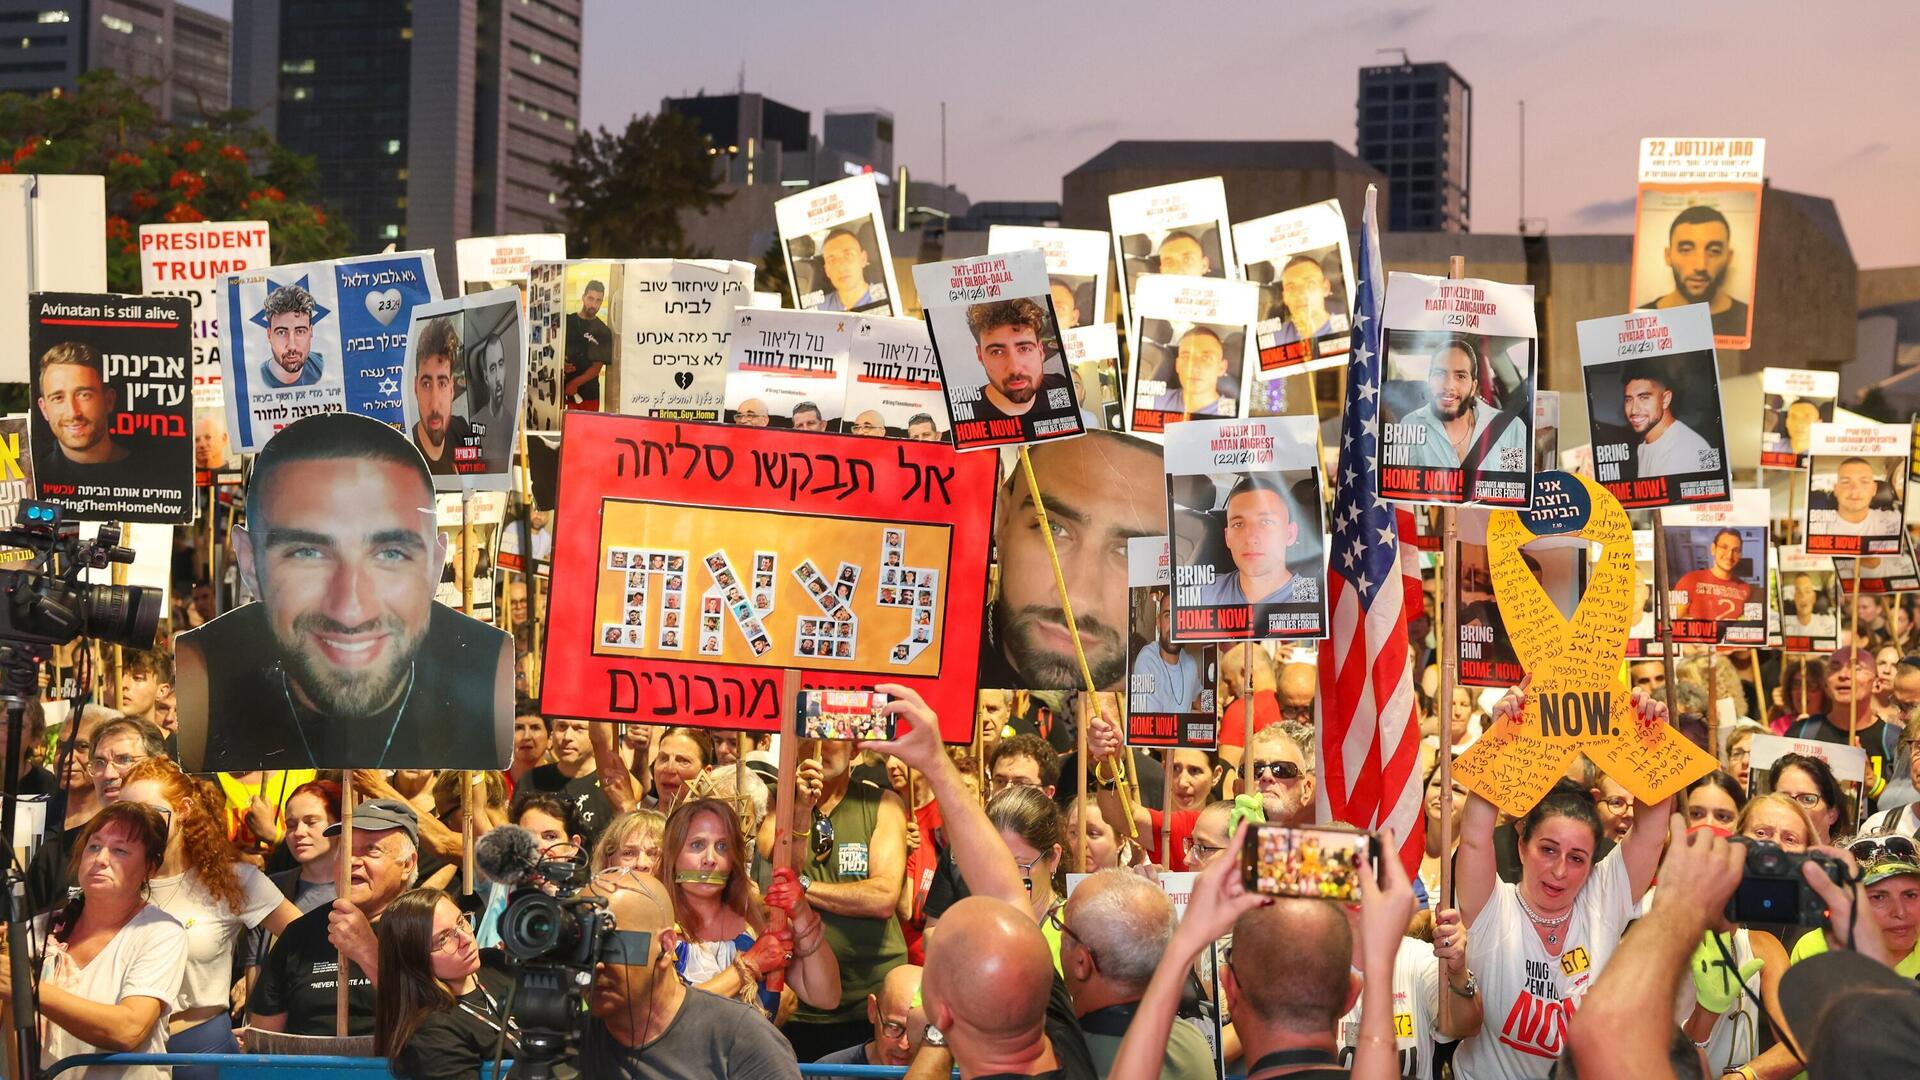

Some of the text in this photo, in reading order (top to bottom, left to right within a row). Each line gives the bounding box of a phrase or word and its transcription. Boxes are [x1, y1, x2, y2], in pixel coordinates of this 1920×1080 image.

[1650, 141, 1666, 157] 22
[141, 230, 266, 251] PRESIDENT
[152, 260, 248, 282] TRUMP
[341, 269, 418, 288] גיא גלבוע דלאל
[950, 271, 1014, 289] GUY GILBOA-DALAL
[640, 281, 719, 292] שיחזור שוב
[40, 303, 180, 320] Avinatan is still alive.
[665, 298, 711, 314] לביתו
[1425, 299, 1497, 316] MATAN ZANGAUKER
[1443, 313, 1465, 327] (25)
[346, 336, 375, 352] בבית
[637, 332, 708, 345] מזה אנחנו
[759, 330, 826, 352] טל וליאור
[1618, 326, 1669, 343] EVYATAR DAVID
[652, 352, 723, 366] לא צריכים
[744, 350, 834, 374] חייבים לחזור
[878, 342, 918, 363] וליאור
[102, 354, 185, 383] אבינתן
[863, 361, 903, 381] לחזור
[126, 383, 186, 412] עדיין
[949, 384, 982, 403] BRING
[254, 405, 288, 421] לחזור
[951, 401, 975, 421] HIM
[109, 413, 187, 437] בחיים.
[955, 416, 1023, 442] HOME NOW!
[1035, 421, 1079, 435] FAMILIES FORUM
[1384, 423, 1426, 445] BRING
[1211, 437, 1275, 451] MATAN ANGREST
[1596, 443, 1630, 463] BRING
[615, 425, 955, 505] אל תבקשו סליחה
[1383, 445, 1409, 466] HIM
[1382, 468, 1464, 493] HOME NOW!
[1598, 462, 1620, 481] HIM
[77, 485, 111, 497] הביתה
[113, 486, 140, 498] אותם
[142, 487, 182, 500] מחזירים
[1475, 487, 1525, 499] FAMILIES FORUM
[1539, 481, 1561, 492] אני
[1633, 476, 1668, 499] NOW!
[1535, 494, 1570, 506] רוצה
[1530, 506, 1580, 521] הביתה
[1176, 564, 1216, 586] BRING
[601, 528, 940, 666] לצאת
[1177, 586, 1202, 606] HIM
[1176, 605, 1254, 631] HOME NOW!
[1268, 619, 1320, 630] FAMILIES FORUM
[1460, 625, 1493, 643] BRING
[1460, 642, 1481, 660] HIM
[1461, 660, 1521, 680] HOME NOW
[1131, 674, 1156, 694] BRING
[1131, 694, 1148, 713] HIM
[1539, 691, 1620, 737] NOW.
[1130, 713, 1178, 736] HOME NOW!
[1561, 946, 1590, 975] 673
